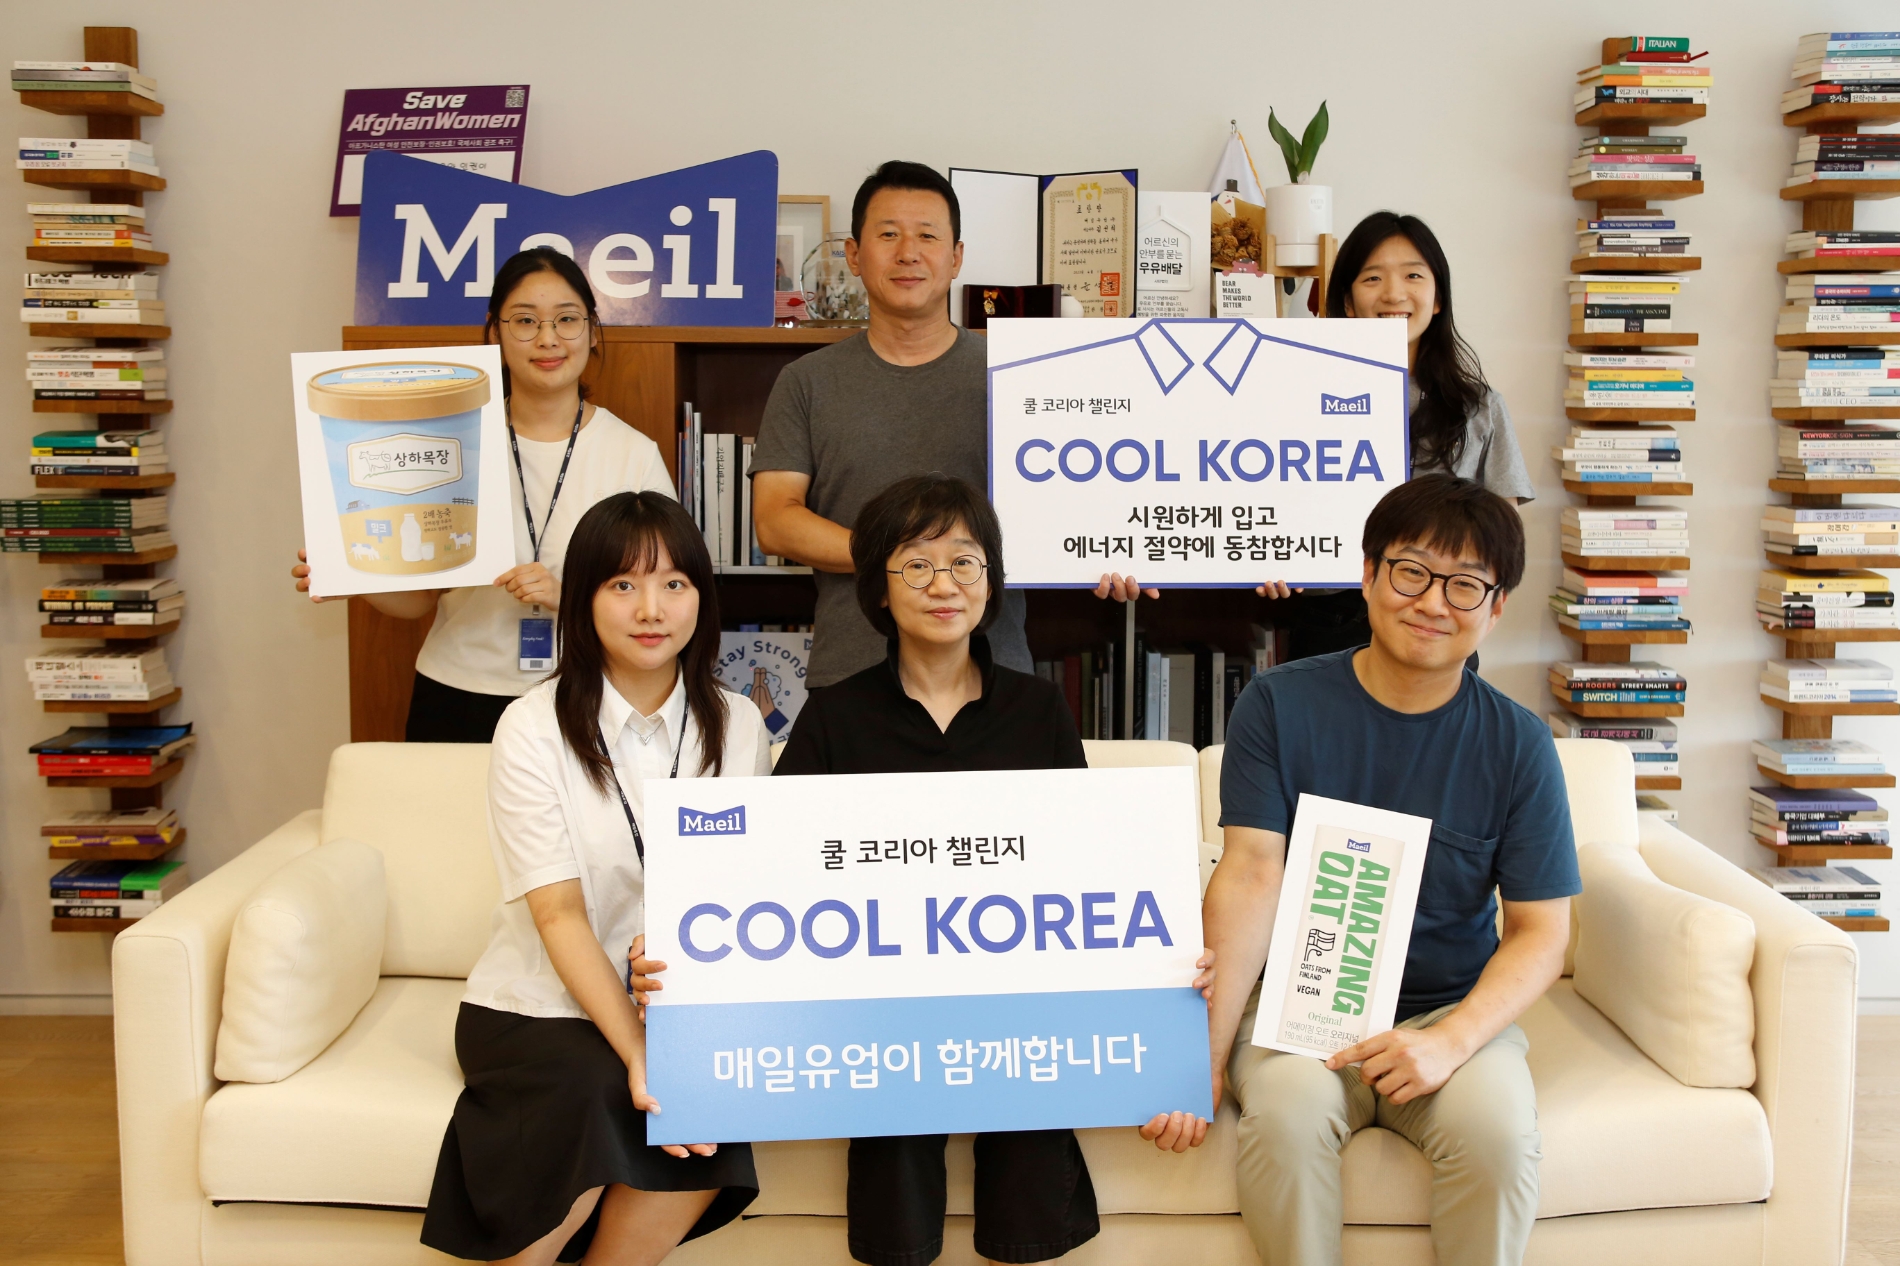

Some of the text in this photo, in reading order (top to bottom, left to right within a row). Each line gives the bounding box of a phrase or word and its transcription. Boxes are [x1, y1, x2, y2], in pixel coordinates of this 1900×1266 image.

[1648, 39, 1677, 48] ITALIAN
[402, 91, 467, 110] Save
[346, 112, 522, 136] AfghanWomen
[1144, 237, 1179, 248] 어르신의
[1139, 249, 1183, 260] 안부를 묻는
[1139, 262, 1183, 276] 우유배달
[1023, 397, 1131, 415] 쿨 코리아 챌린지
[1324, 398, 1368, 413] Maeil
[393, 449, 450, 468] 상하목장
[1015, 438, 1384, 483] COOL KOREA
[34, 466, 55, 475] FLEX
[1127, 505, 1278, 531] 시원하게 입고
[370, 522, 387, 534] 밀크
[1063, 535, 1342, 561] 에너지 절약에 동참합시다
[712, 640, 807, 679] Stay Strong
[1583, 693, 1618, 702] SWITCH
[683, 813, 741, 833] Maeil
[820, 835, 1026, 871] 쿨 코리아 챌린지
[1348, 841, 1370, 852] Maeil
[678, 891, 1174, 963] COOL KOREA
[1309, 850, 1390, 1016] AMAZING OAT
[1299, 970, 1322, 982] FINLAND
[1300, 962, 1332, 975] OATS FROM
[1296, 984, 1321, 996] VEGAN
[1308, 1011, 1343, 1027] Original
[1286, 1020, 1360, 1044] 어메이징 오트 오리지널
[713, 1032, 1147, 1094] 매일유업이 함께합니다
